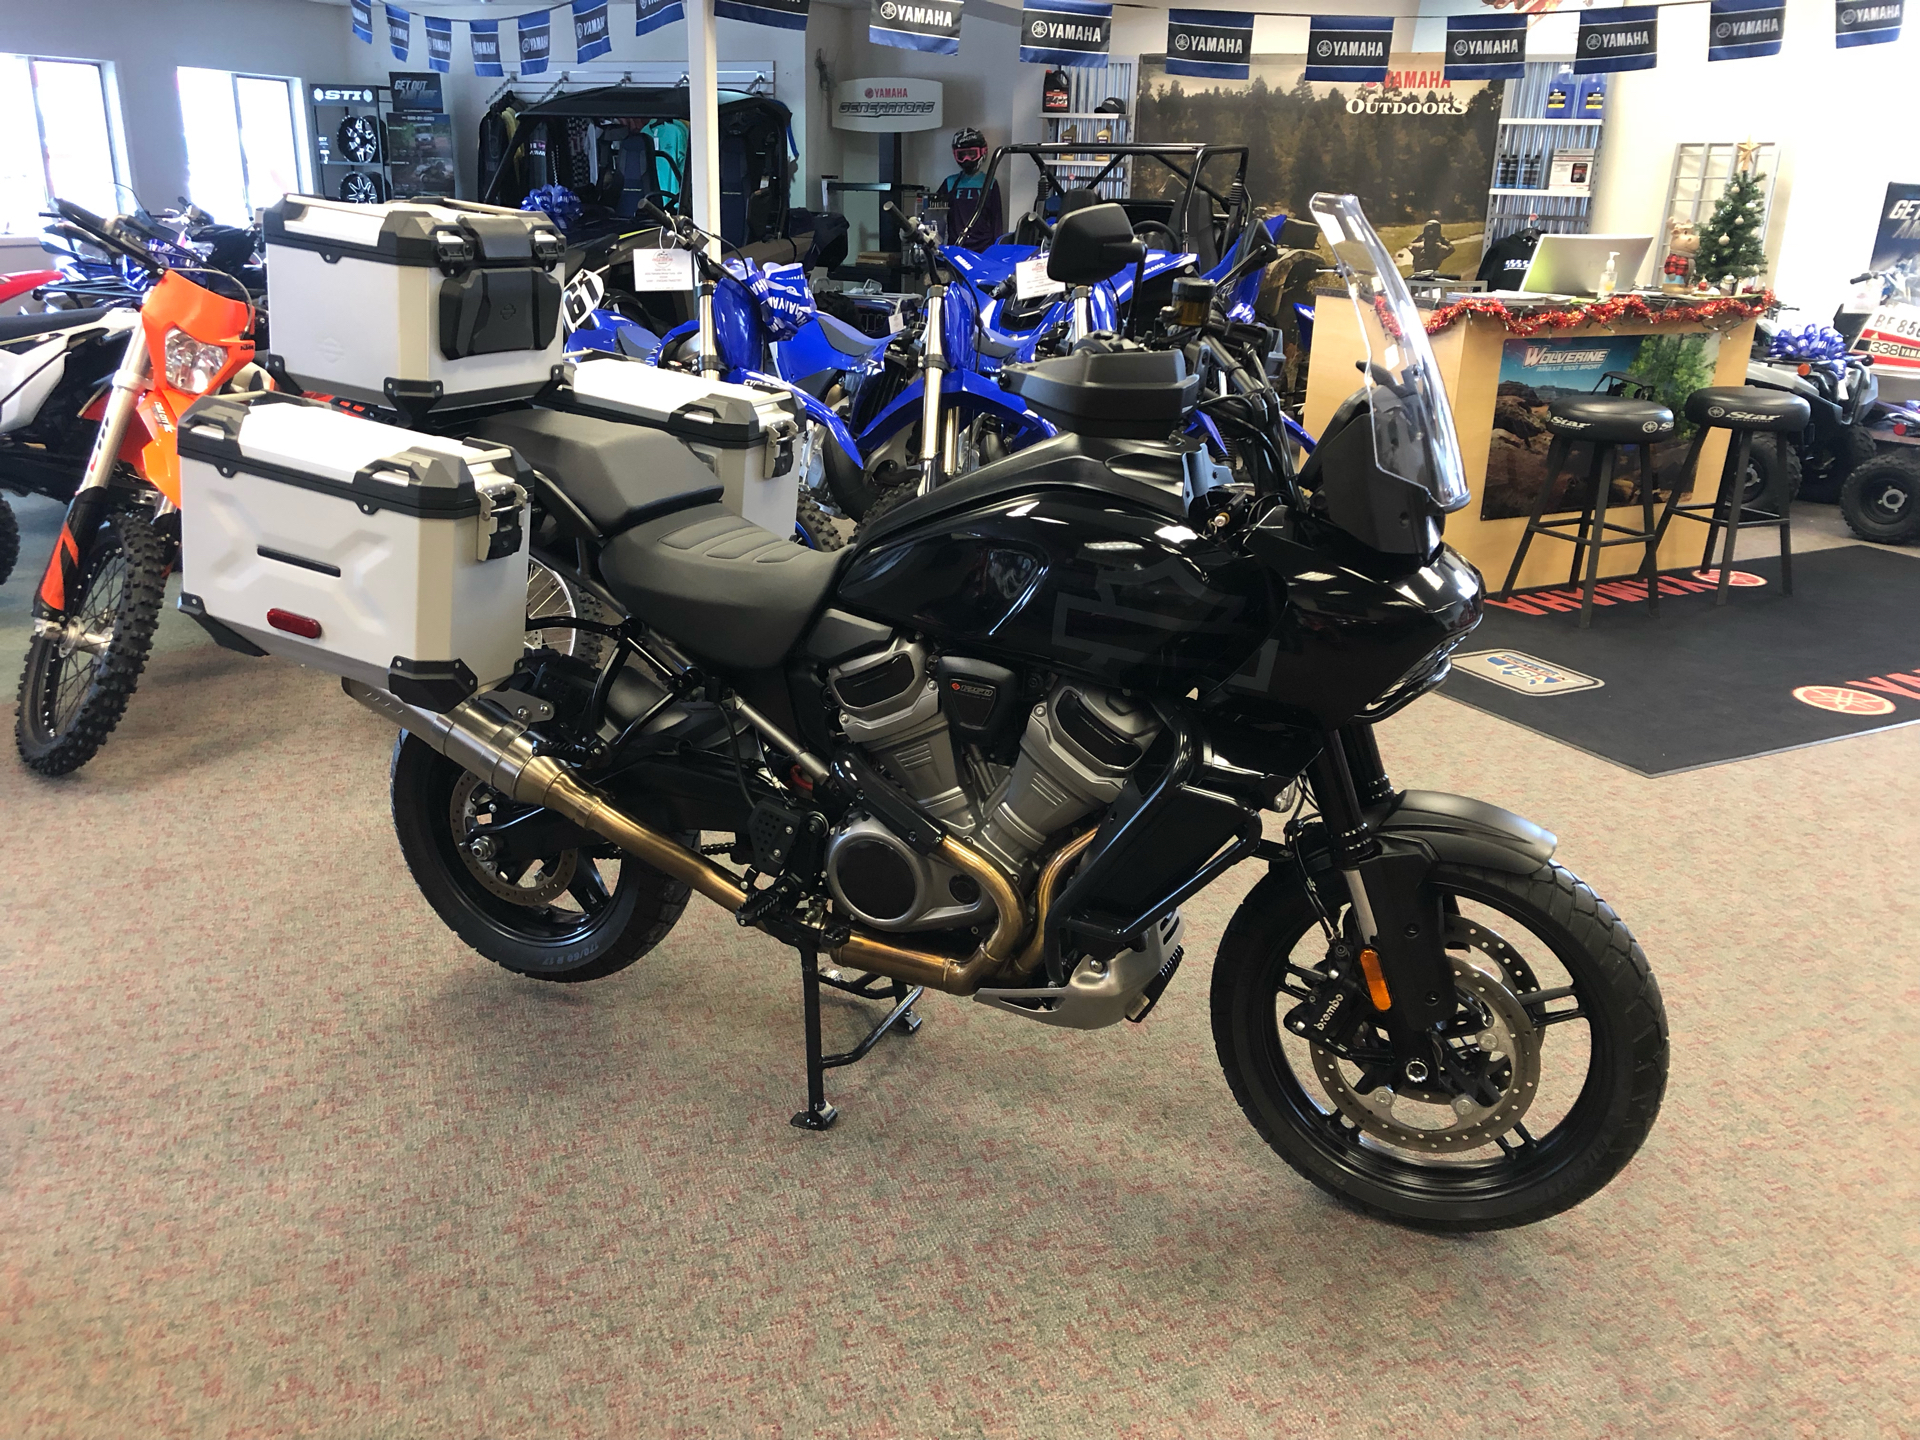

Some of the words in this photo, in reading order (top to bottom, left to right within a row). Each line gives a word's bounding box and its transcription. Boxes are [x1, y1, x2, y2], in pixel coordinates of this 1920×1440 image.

[897, 4, 953, 28] YAMAHA
[1856, 5, 1900, 23] YAMAHA
[1048, 22, 1102, 43] YAMAHA
[1731, 17, 1779, 37] YAMAHA
[1191, 35, 1244, 55] YAMAHA
[1469, 38, 1519, 56] YAMAHA
[1602, 30, 1650, 47] YAMAHA
[1333, 40, 1384, 58] YAMAHA
[394, 80, 411, 91] GET
[411, 80, 428, 91] OUT
[1384, 70, 1452, 89] YAMAHA
[325, 89, 362, 101] STI
[874, 87, 908, 98] YAMAHA
[839, 101, 935, 114] GENERATORS
[1345, 99, 1469, 115] OUTDOORS
[1524, 346, 1608, 366] WOLVERINE
[1870, 341, 1900, 356] 338
[1551, 416, 1591, 428] Star
[1725, 411, 1781, 420] Star
[1313, 993, 1344, 1031] brembo
